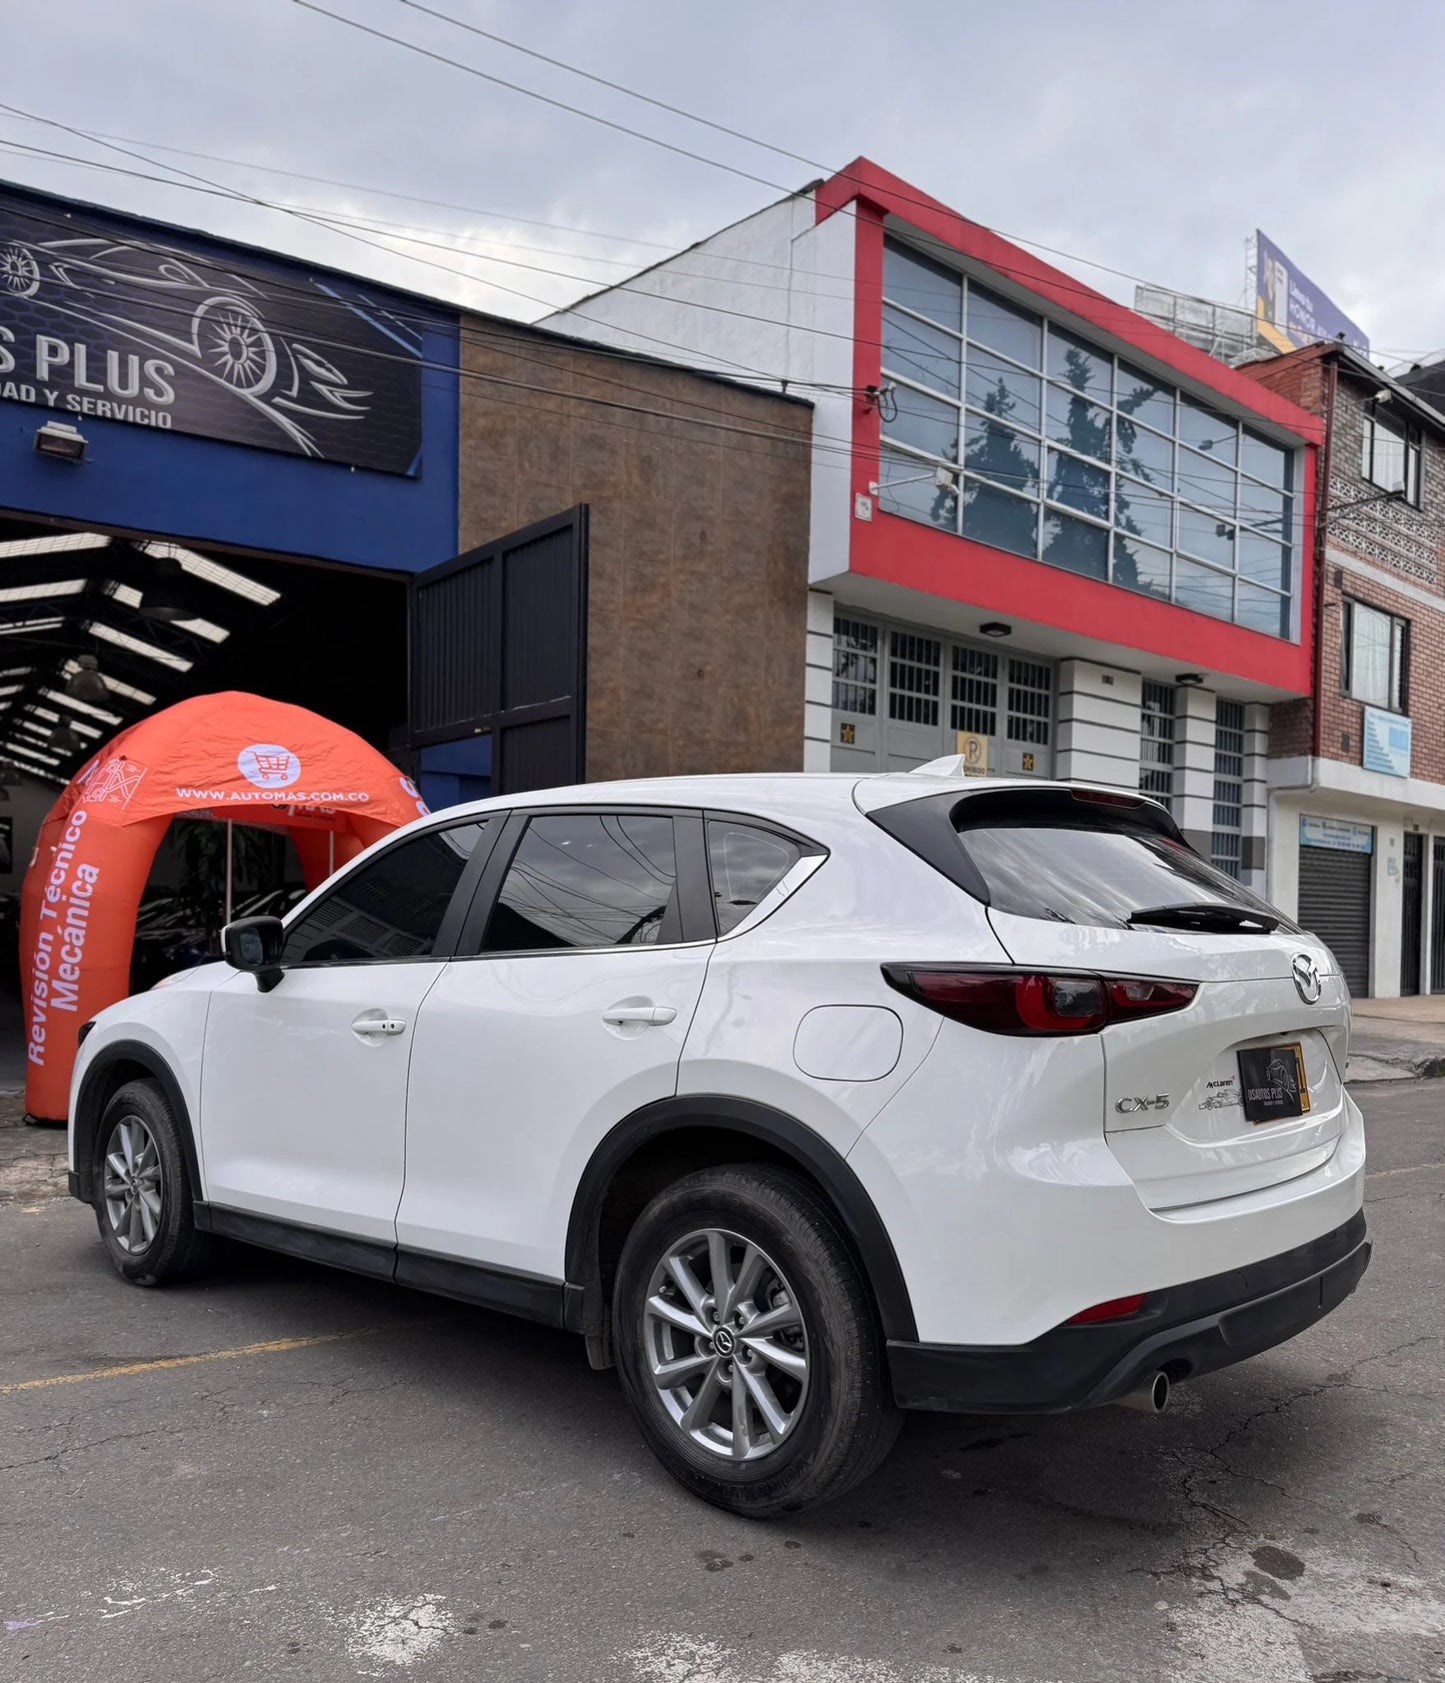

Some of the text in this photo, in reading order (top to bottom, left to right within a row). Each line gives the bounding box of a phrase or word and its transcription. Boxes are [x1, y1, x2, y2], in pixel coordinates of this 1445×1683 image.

[36, 334, 176, 405] PLUS
[0, 381, 172, 429] AD Y SERVICIO
[176, 788, 370, 802] WWW.AUTOMAS.COM.CO
[28, 810, 87, 1066] Revisión Técnico
[50, 863, 99, 1012] Mecánica
[1115, 1093, 1169, 1113] CX-5
